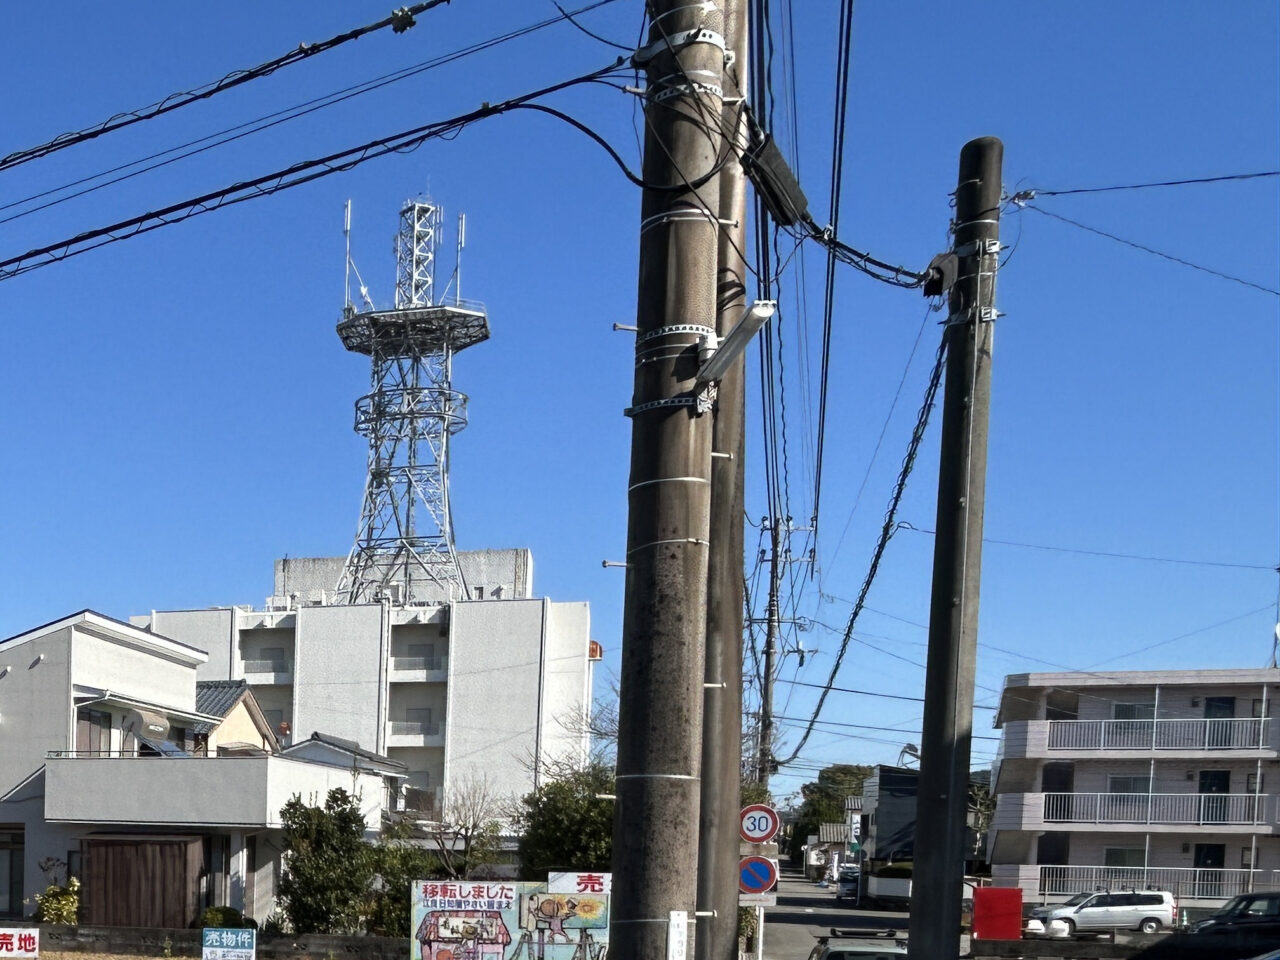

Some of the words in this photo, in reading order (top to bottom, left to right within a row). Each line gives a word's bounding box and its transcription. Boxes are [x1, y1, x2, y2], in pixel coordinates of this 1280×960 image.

[745, 815, 769, 832] 30
[422, 883, 514, 899] 移転しました
[576, 873, 604, 893] 売
[205, 930, 252, 947] 売物件
